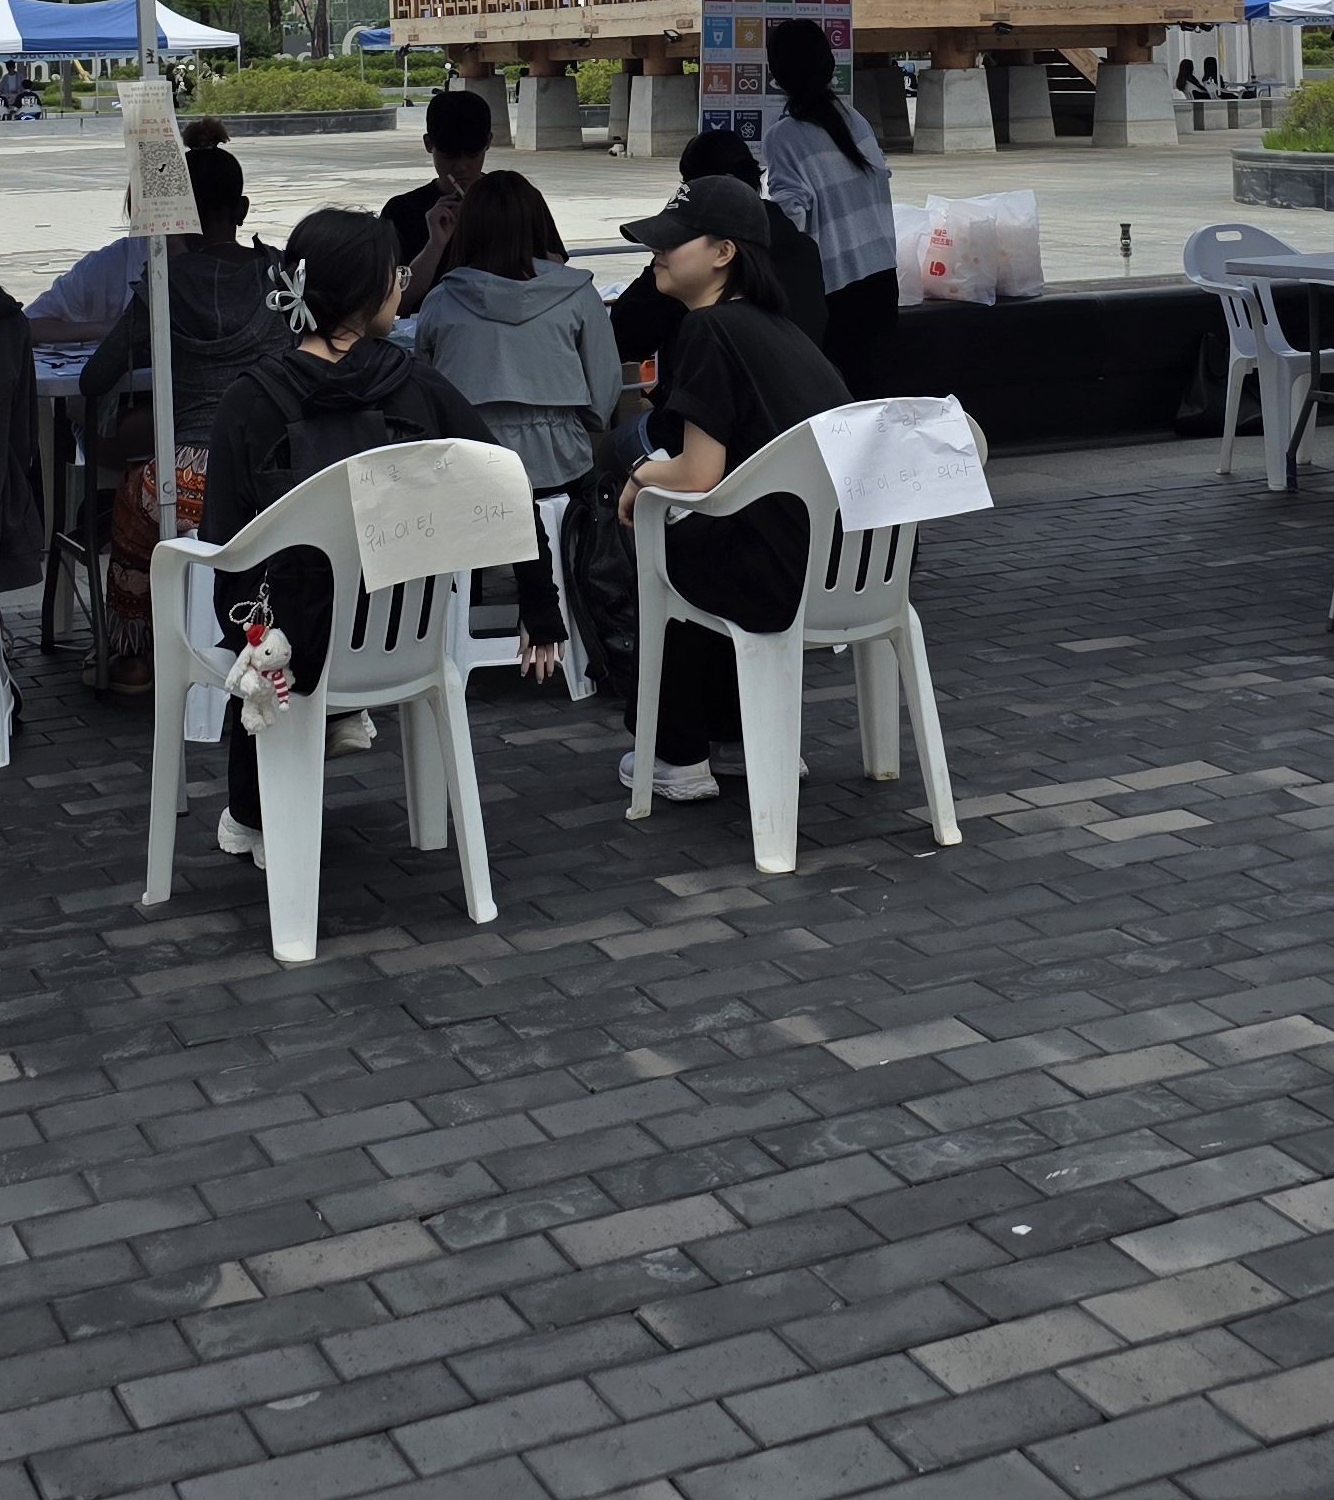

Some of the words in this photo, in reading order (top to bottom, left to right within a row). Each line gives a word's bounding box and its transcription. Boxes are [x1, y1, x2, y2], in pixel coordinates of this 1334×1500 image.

[843, 469, 922, 501] 웨이팅
[937, 459, 977, 479] 의자
[364, 512, 435, 553] 웨이팅
[472, 502, 514, 524] 의자
